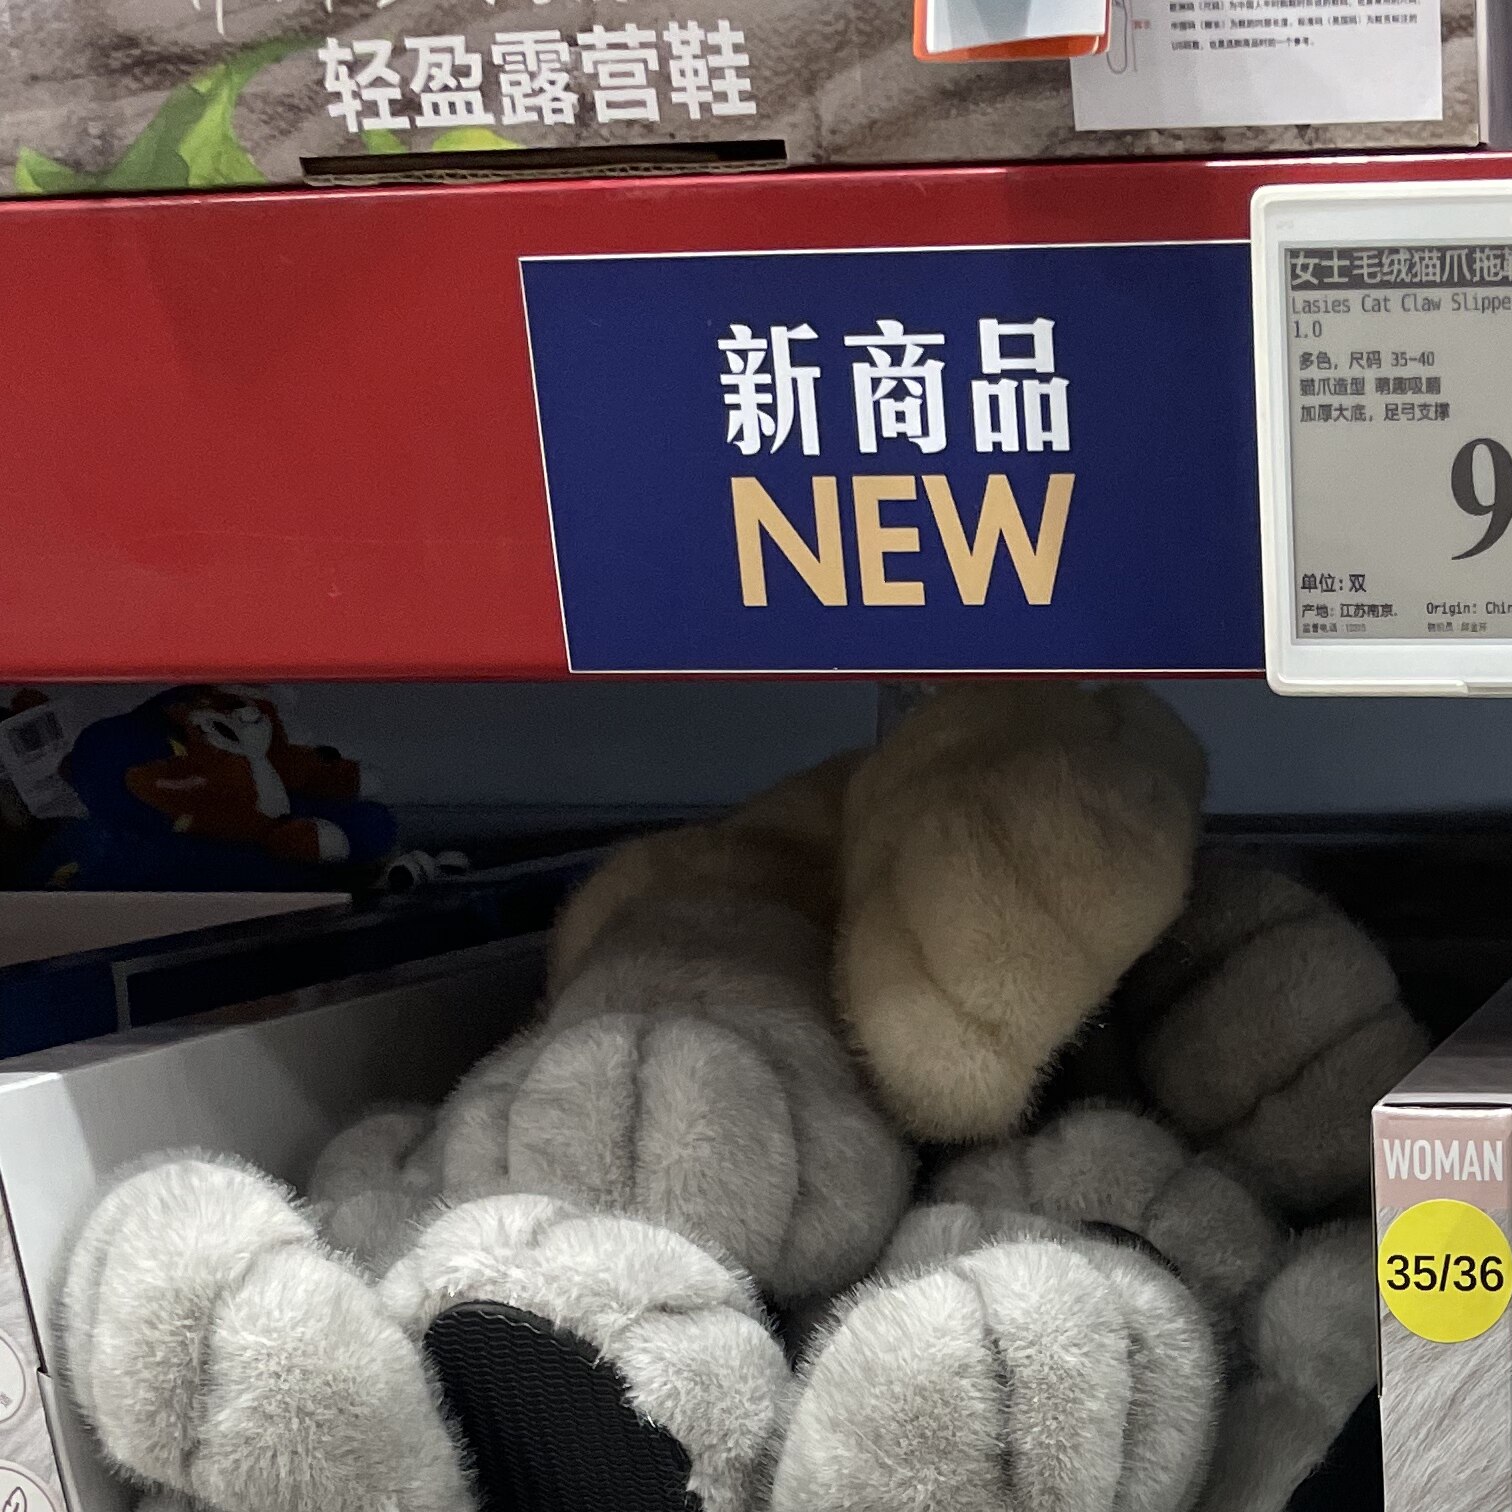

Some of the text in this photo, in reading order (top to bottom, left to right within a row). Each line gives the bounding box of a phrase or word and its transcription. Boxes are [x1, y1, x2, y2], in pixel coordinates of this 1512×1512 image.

[318, 20, 757, 131] 轻盈露营鞋
[1291, 296, 1351, 315] Lasies
[1361, 294, 1392, 314] Cat
[1401, 293, 1442, 312] Claw
[1293, 319, 1323, 339] 1.0
[1390, 350, 1436, 369] 35-40
[717, 317, 1071, 457] 新商品
[1299, 376, 1366, 396] 猫爪造型
[730, 473, 1077, 608] NEW
[1426, 601, 1478, 617] Origin:
[1382, 1137, 1504, 1182] WOMAN
[1385, 1253, 1505, 1293] 35/36
